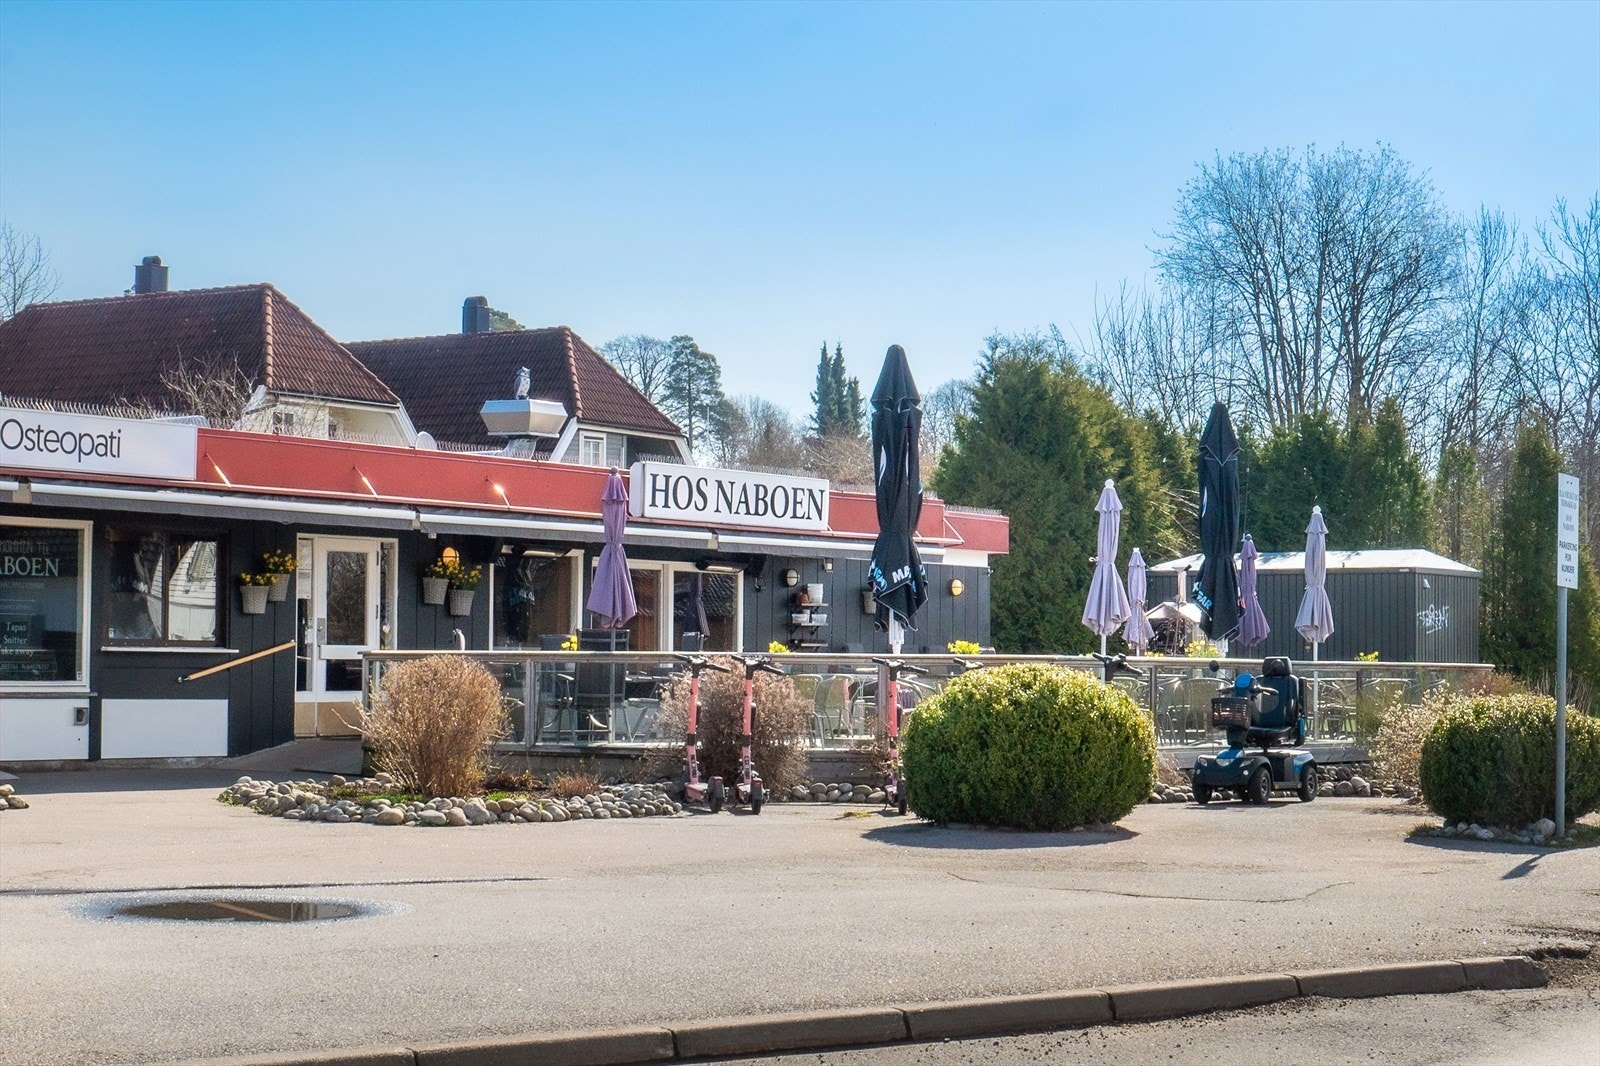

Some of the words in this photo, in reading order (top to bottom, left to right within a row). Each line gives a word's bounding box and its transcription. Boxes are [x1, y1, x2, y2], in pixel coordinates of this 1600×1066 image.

[0, 418, 122, 463] Osteopati
[649, 473, 708, 512] HOS
[714, 479, 825, 521] NABOEN
[0, 555, 60, 577] BOEN
[6, 621, 27, 633] Tapas
[0, 645, 14, 655] ake
